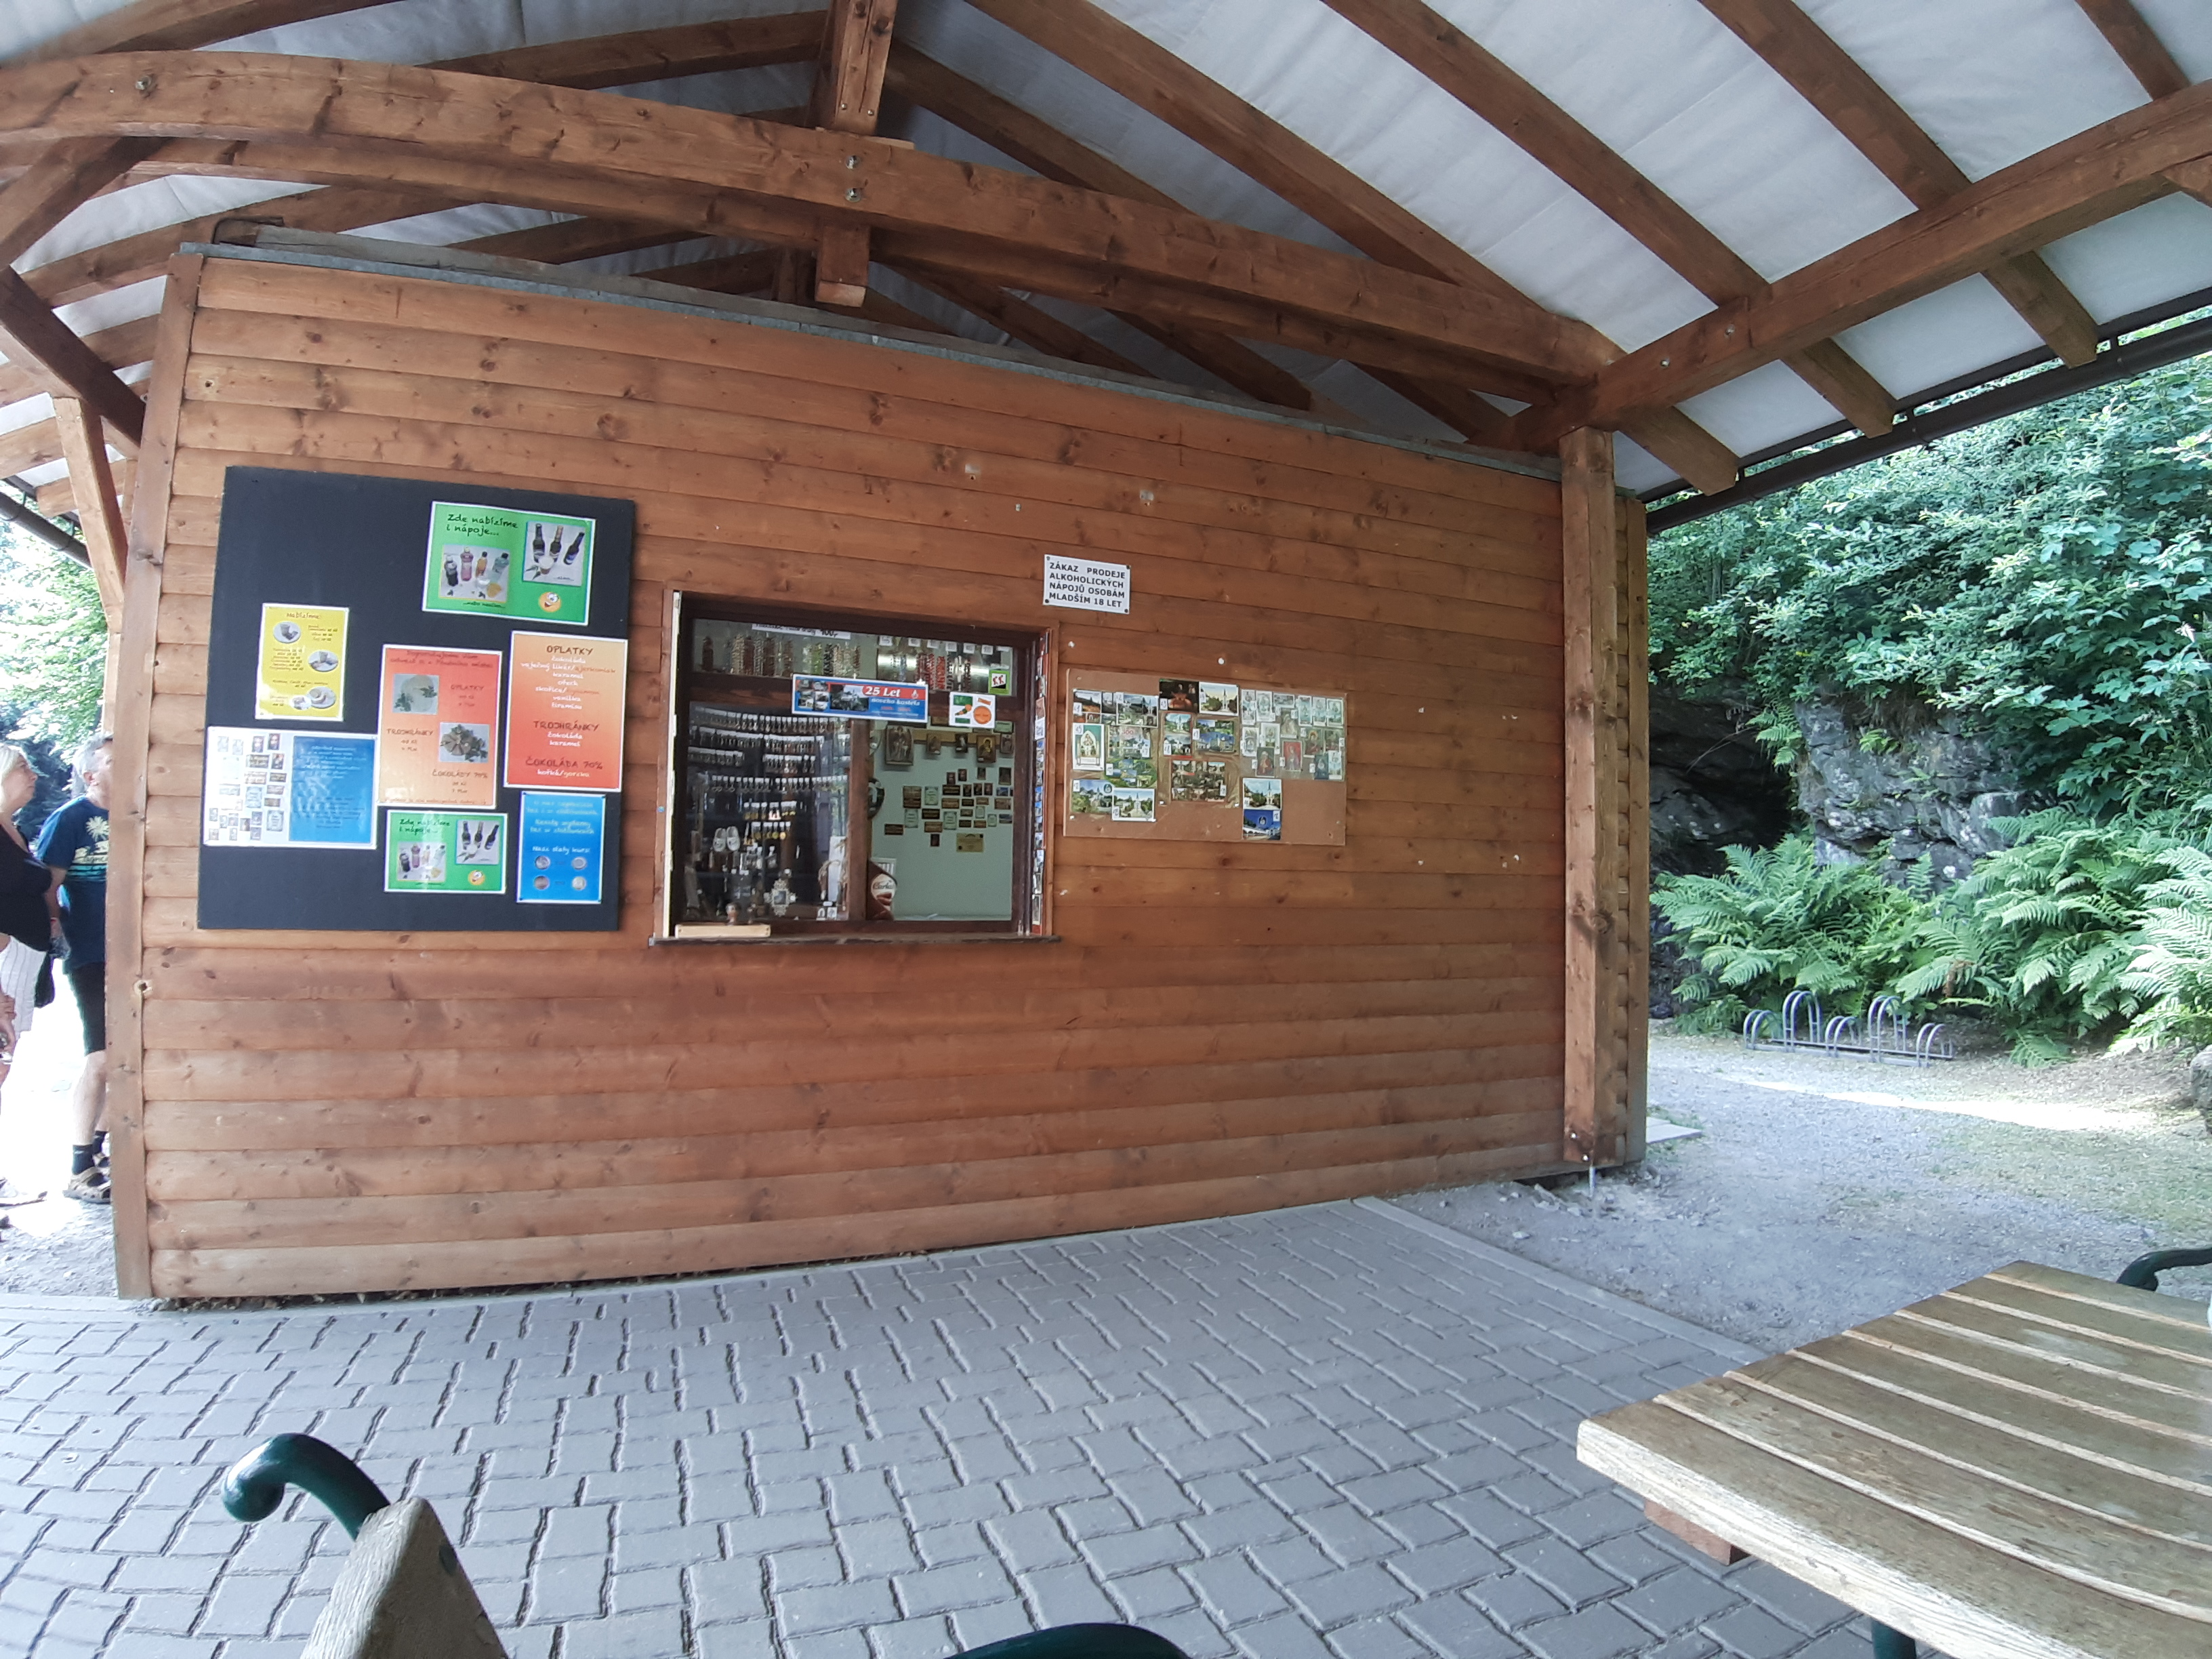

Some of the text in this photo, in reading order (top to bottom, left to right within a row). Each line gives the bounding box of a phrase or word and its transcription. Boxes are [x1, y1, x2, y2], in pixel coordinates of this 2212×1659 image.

[447, 514, 468, 523] Zde
[1050, 561, 1126, 579] ZÁKAZ PRODEJE
[1049, 572, 1124, 588] ALKOHOLICKÝCH
[1049, 581, 1125, 598] NÁPOJŮ OSOBÁM
[1049, 592, 1090, 604] MLADŠÍM
[546, 645, 594, 655] OPLATKY
[865, 686, 901, 697] 25 Let
[533, 720, 600, 732] TROJHRÁNKY
[525, 756, 603, 770] ČOKOLÁDA 70%
